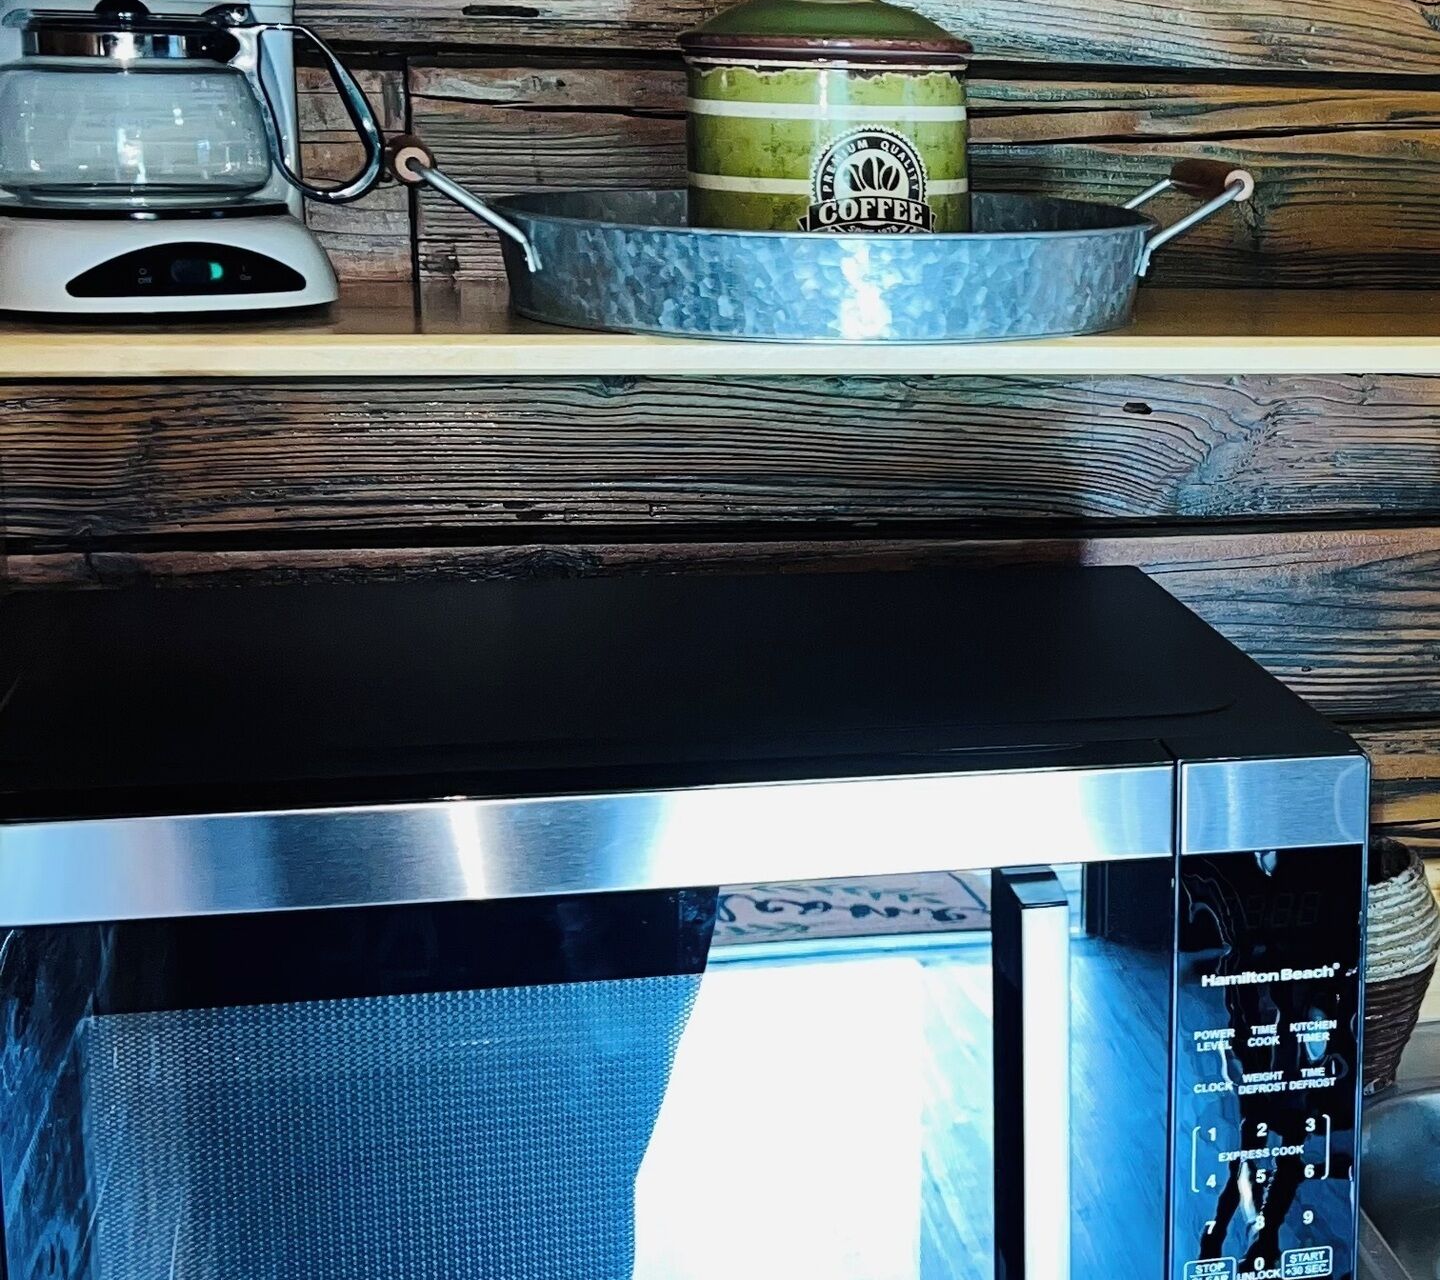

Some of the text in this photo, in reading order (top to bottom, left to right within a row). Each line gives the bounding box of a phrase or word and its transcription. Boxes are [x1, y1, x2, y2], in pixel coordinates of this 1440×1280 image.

[822, 138, 920, 193] PREMIUM QUALITY
[818, 197, 923, 225] COFFEE
[1201, 970, 1279, 988] Hamilton
[1250, 1024, 1277, 1036] TIME
[1289, 1019, 1337, 1032] KITCHEN
[1193, 1028, 1235, 1041] POWER
[1247, 1035, 1280, 1047] COOK
[1296, 1032, 1330, 1043] TIMER
[1196, 1040, 1232, 1052] LEVEL
[1242, 1070, 1284, 1083] WEIGHT
[1300, 1067, 1325, 1078] TIME
[1193, 1081, 1234, 1094] CLOCK
[1238, 1081, 1288, 1095] DEFROST
[1289, 1077, 1336, 1091] DEFROST
[1256, 1122, 1268, 1137] 2
[1305, 1117, 1316, 1132] 3
[1207, 1127, 1217, 1142] 1
[1218, 1144, 1305, 1162] EXPRESS COOK
[1255, 1169, 1267, 1184] 5
[1304, 1164, 1315, 1179] 6
[1205, 1174, 1217, 1189] 4
[1255, 1215, 1266, 1230] 8
[1302, 1210, 1314, 1225] 9
[1205, 1220, 1217, 1235] 7
[1254, 1257, 1265, 1271] 0
[1289, 1251, 1326, 1264] START
[1194, 1262, 1226, 1274] STOP
[1285, 1265, 1304, 1276] +30
